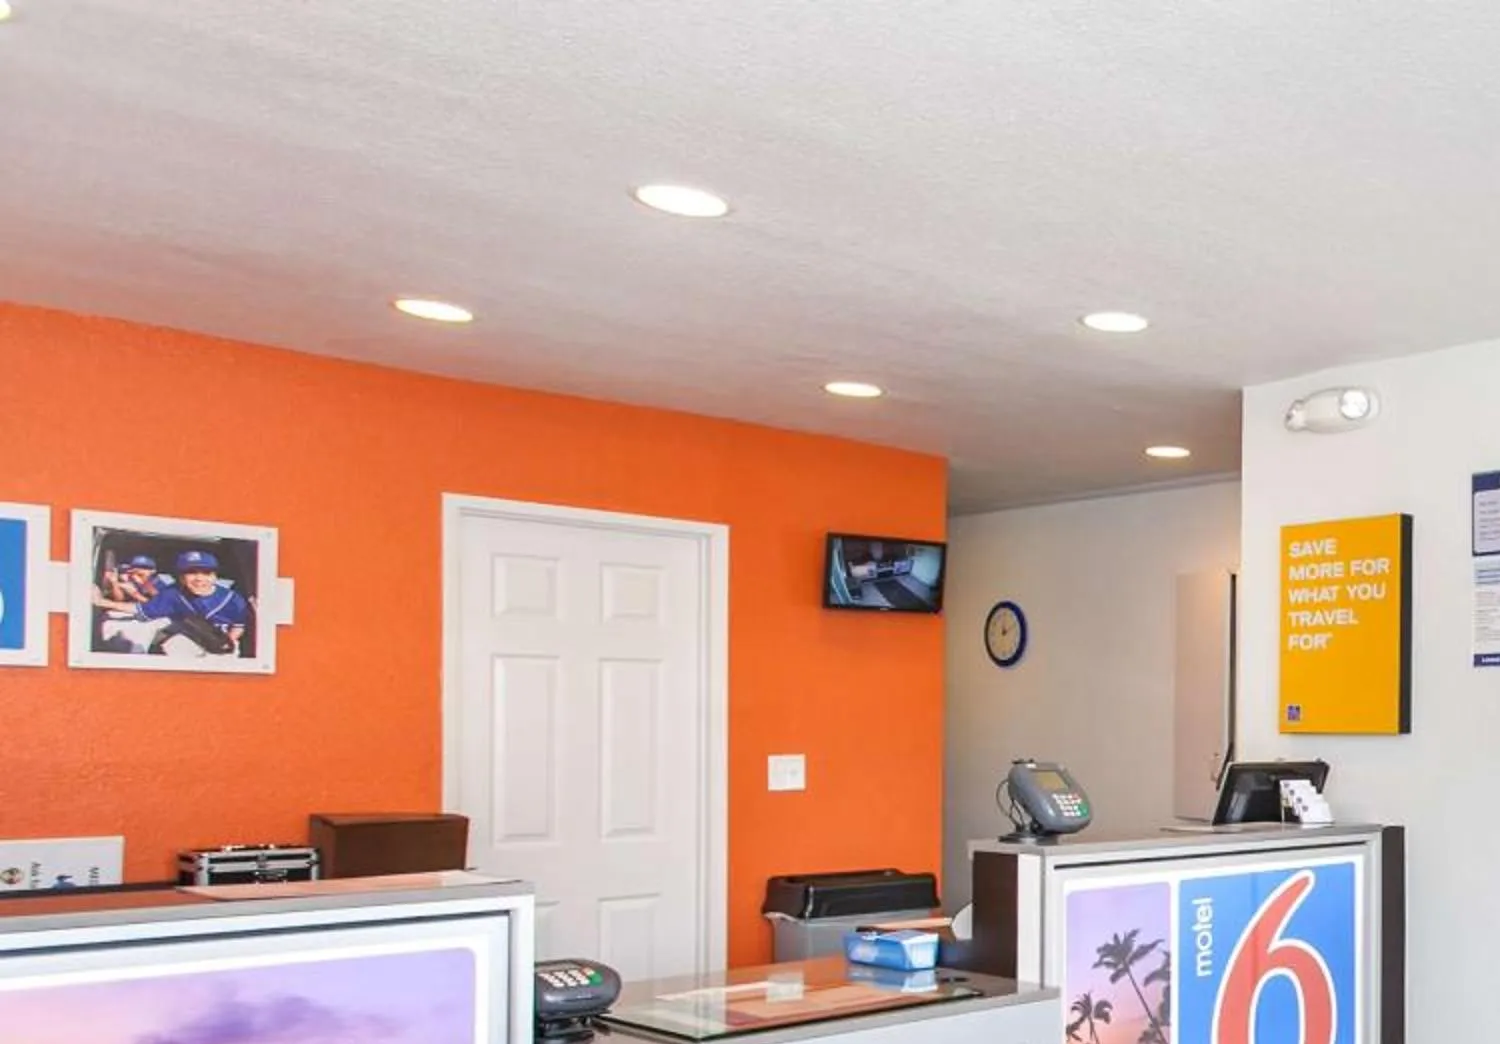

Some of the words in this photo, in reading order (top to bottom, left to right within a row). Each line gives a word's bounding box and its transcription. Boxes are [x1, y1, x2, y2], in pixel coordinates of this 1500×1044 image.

[1288, 538, 1337, 558] SAVE
[1288, 561, 1344, 581] MORE
[1350, 557, 1390, 577] FOR
[1288, 586, 1341, 604] WHAT
[1346, 582, 1386, 601] YOU
[1288, 608, 1359, 627] TRAVEL
[1192, 897, 1213, 977] motel
